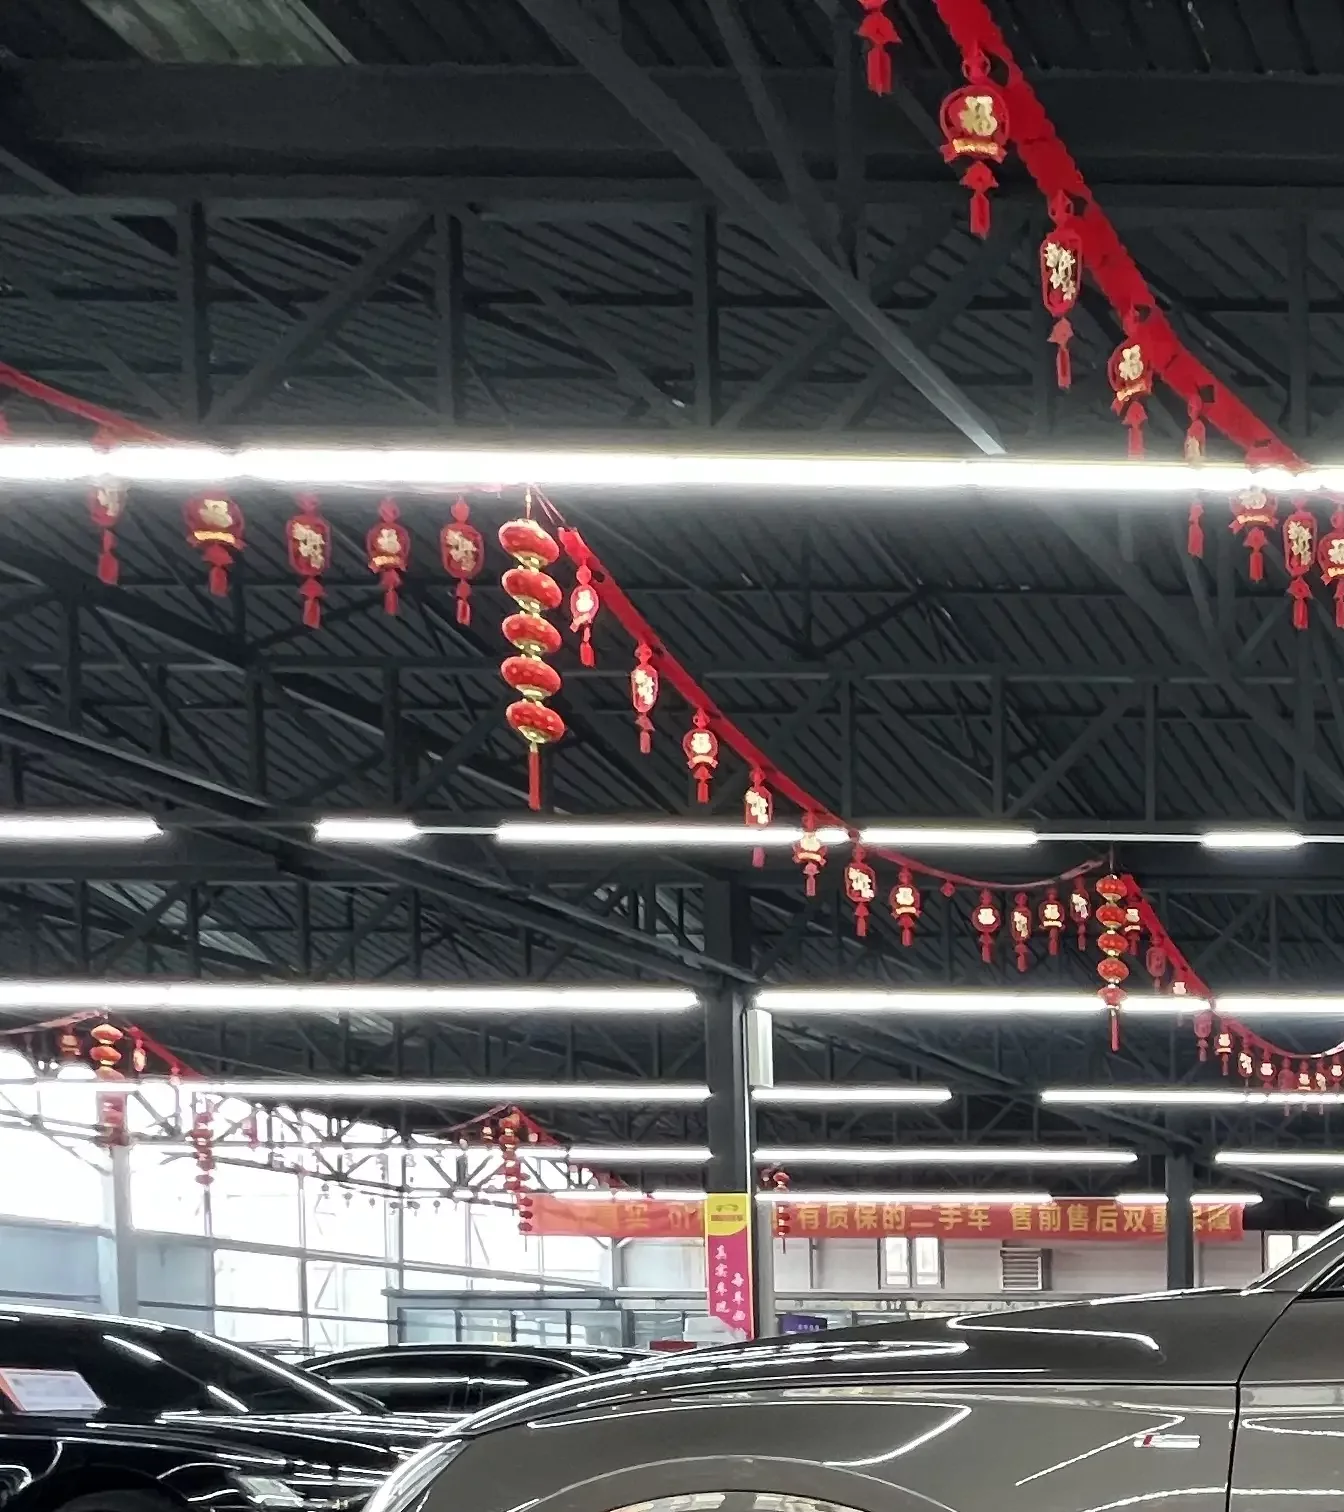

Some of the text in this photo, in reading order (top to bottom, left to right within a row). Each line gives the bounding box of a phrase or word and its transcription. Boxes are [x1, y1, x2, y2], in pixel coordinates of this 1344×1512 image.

[773, 1203, 992, 1232] 有质保的二手车
